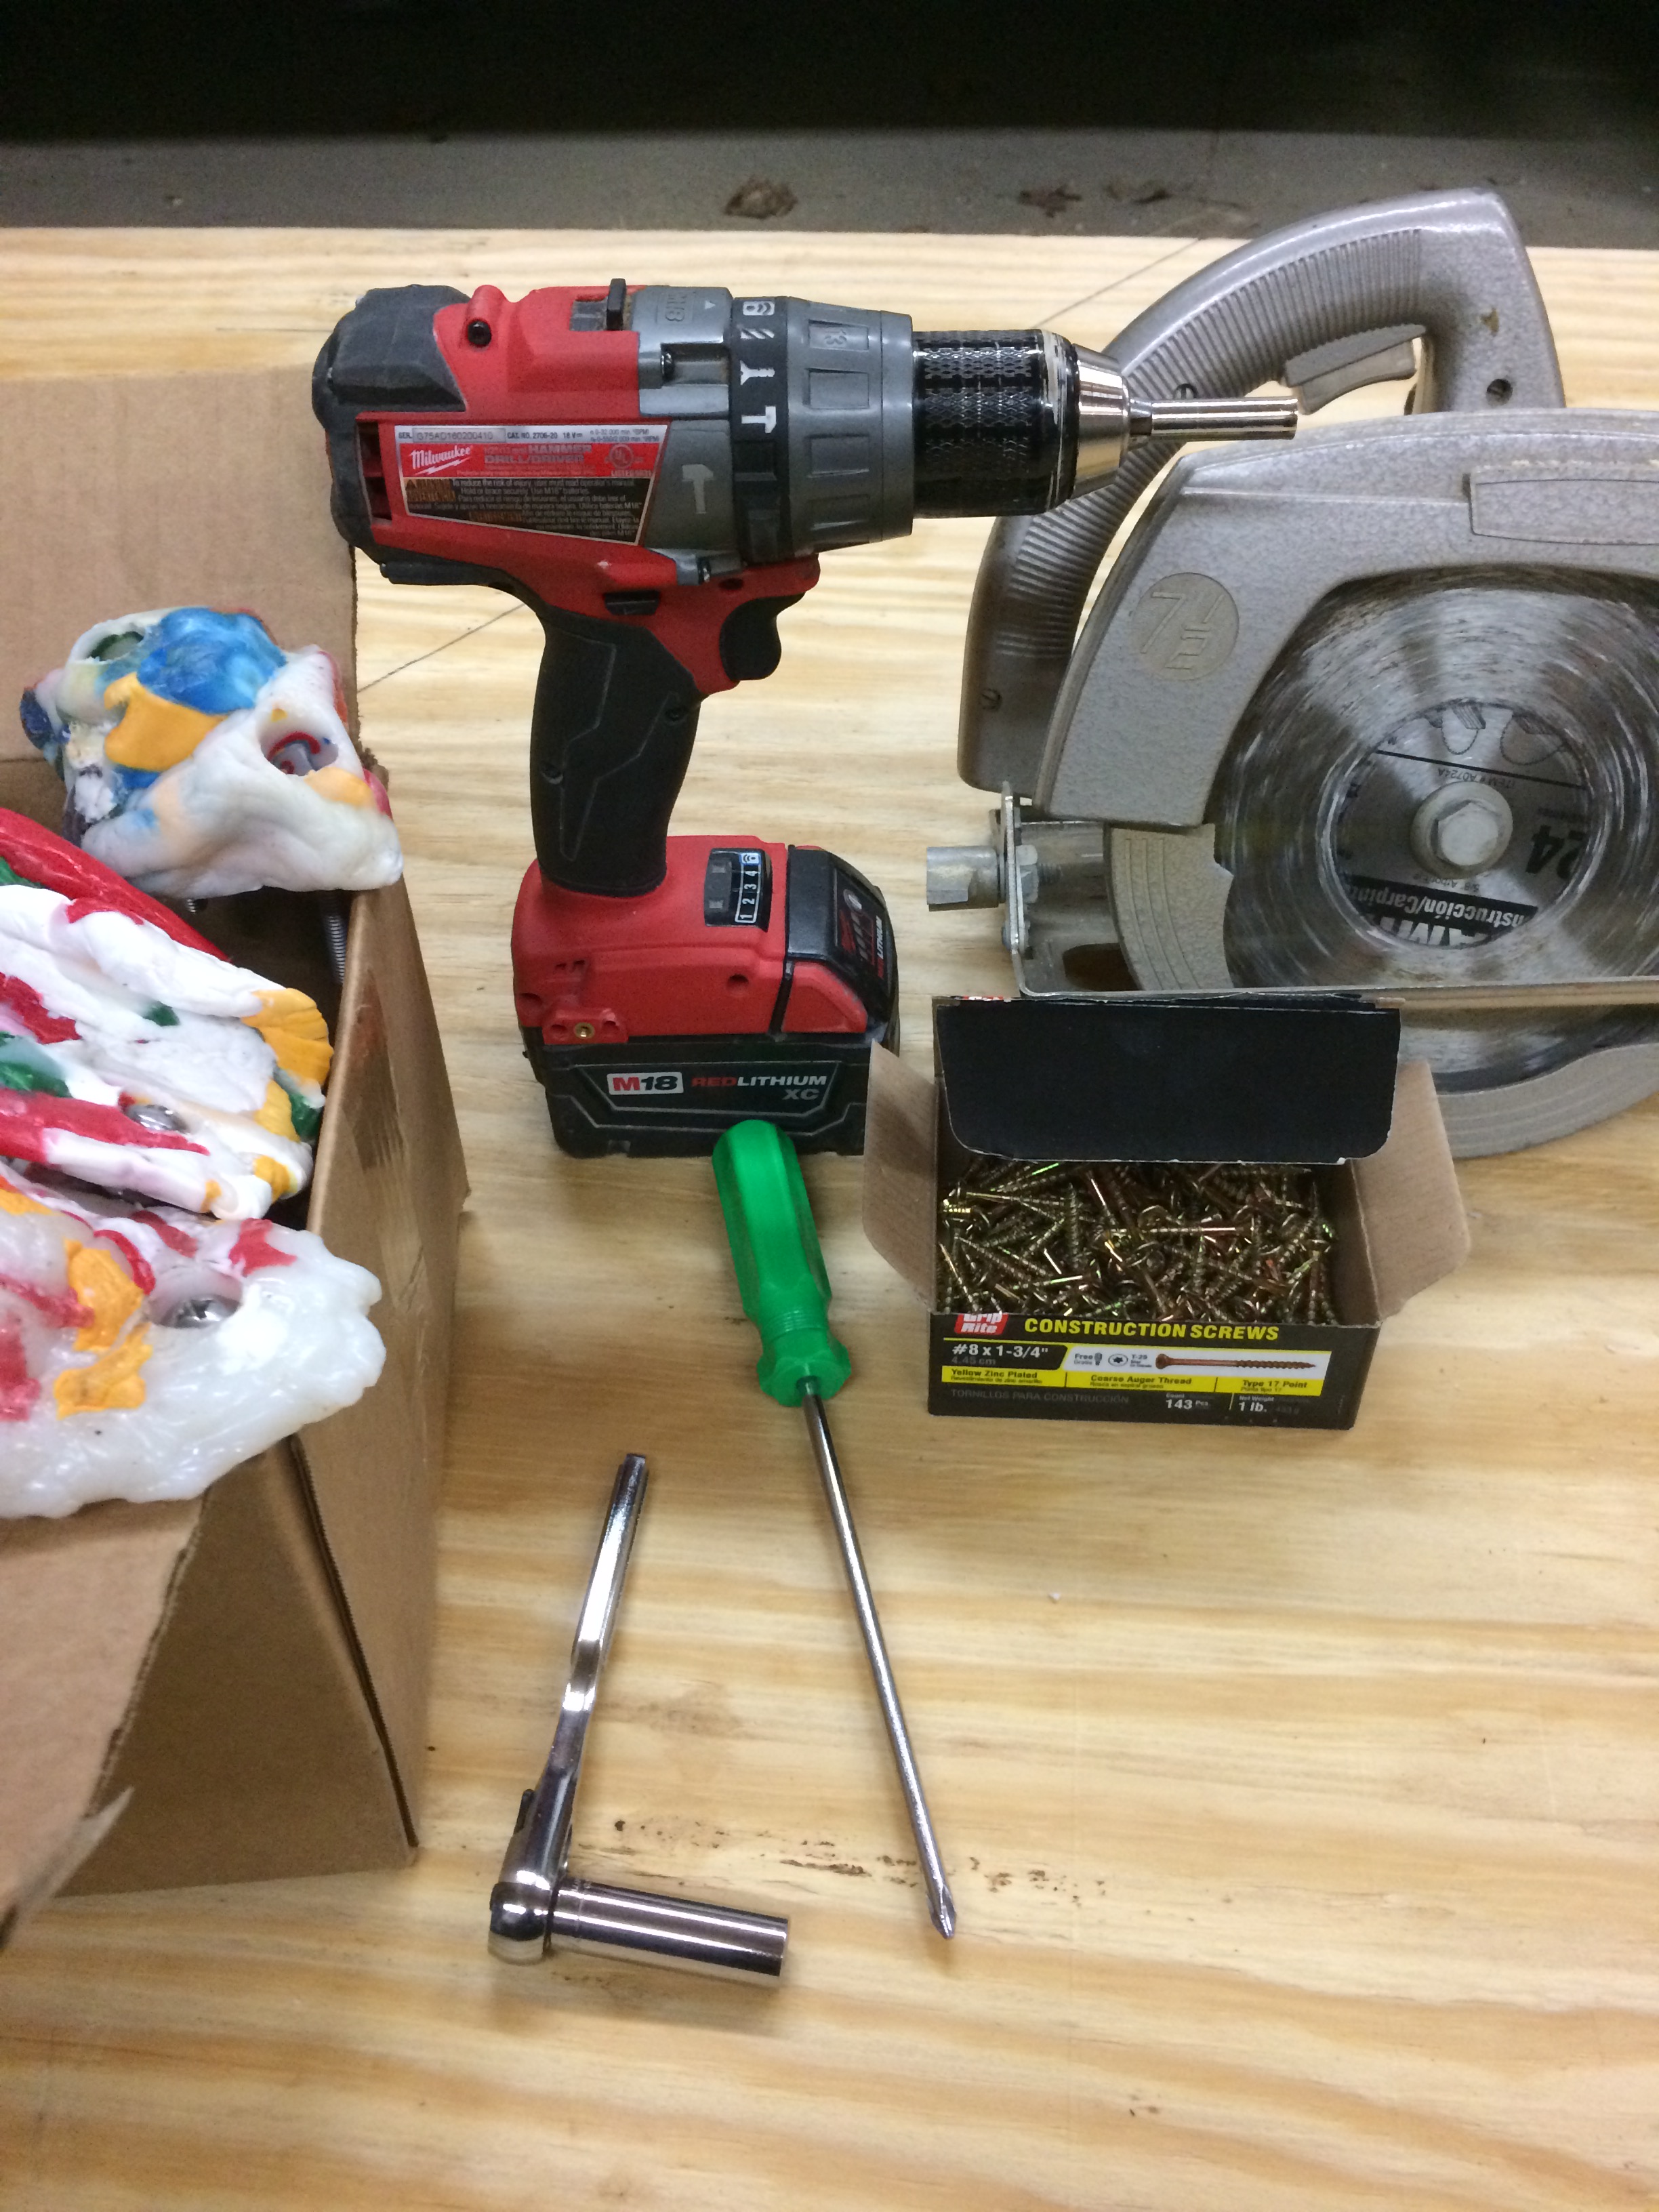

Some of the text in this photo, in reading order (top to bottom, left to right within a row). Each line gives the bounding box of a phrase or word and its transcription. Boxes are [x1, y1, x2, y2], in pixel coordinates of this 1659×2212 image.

[409, 445, 473, 470] Milwaukee
[745, 869, 758, 878] 4
[613, 1075, 827, 1092] M18 REDLITHIUM
[782, 1089, 820, 1101] XC
[961, 1322, 998, 1334] Rite
[1024, 1317, 1279, 1341] CONSTRUCTION SCREWS
[952, 1343, 1048, 1359] #8 x 1-3/4"
[951, 1356, 976, 1365] 4.45
[951, 1368, 982, 1376] Yellow
[1127, 1376, 1155, 1385] Auger
[1242, 1379, 1264, 1388] Type
[1283, 1380, 1308, 1389] Point
[951, 1389, 1010, 1400] TORNILLOS
[1012, 1393, 1041, 1401] PARA
[1166, 1399, 1193, 1410] 143
[1239, 1402, 1267, 1412] 1 lb.
